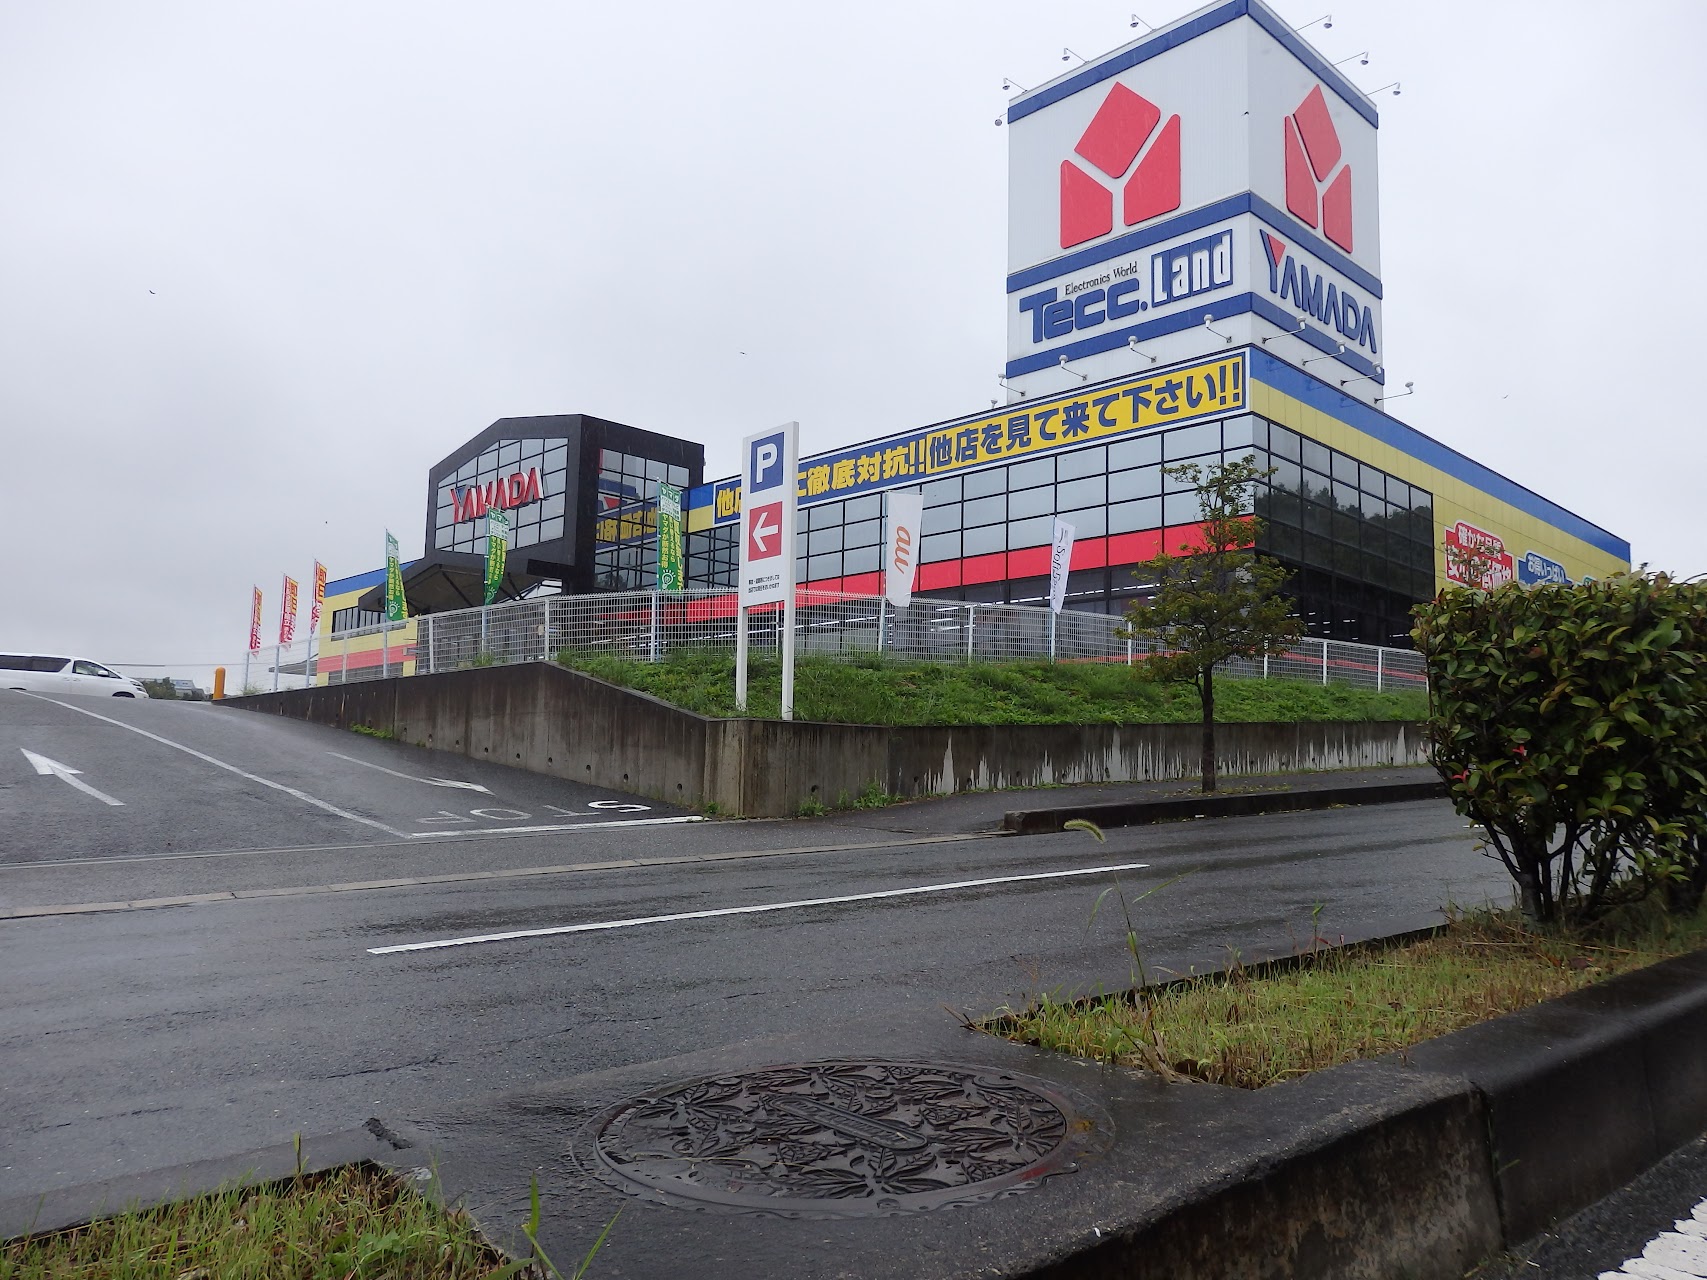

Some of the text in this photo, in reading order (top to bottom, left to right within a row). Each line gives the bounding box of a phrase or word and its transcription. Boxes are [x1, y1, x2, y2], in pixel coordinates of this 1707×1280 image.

[1065, 261, 1138, 296] Electronics World
[1260, 229, 1377, 354] YAMADA
[756, 443, 778, 484] P
[450, 467, 544, 523] YAMADA
[894, 525, 911, 575] au
[415, 800, 652, 824] STOP
